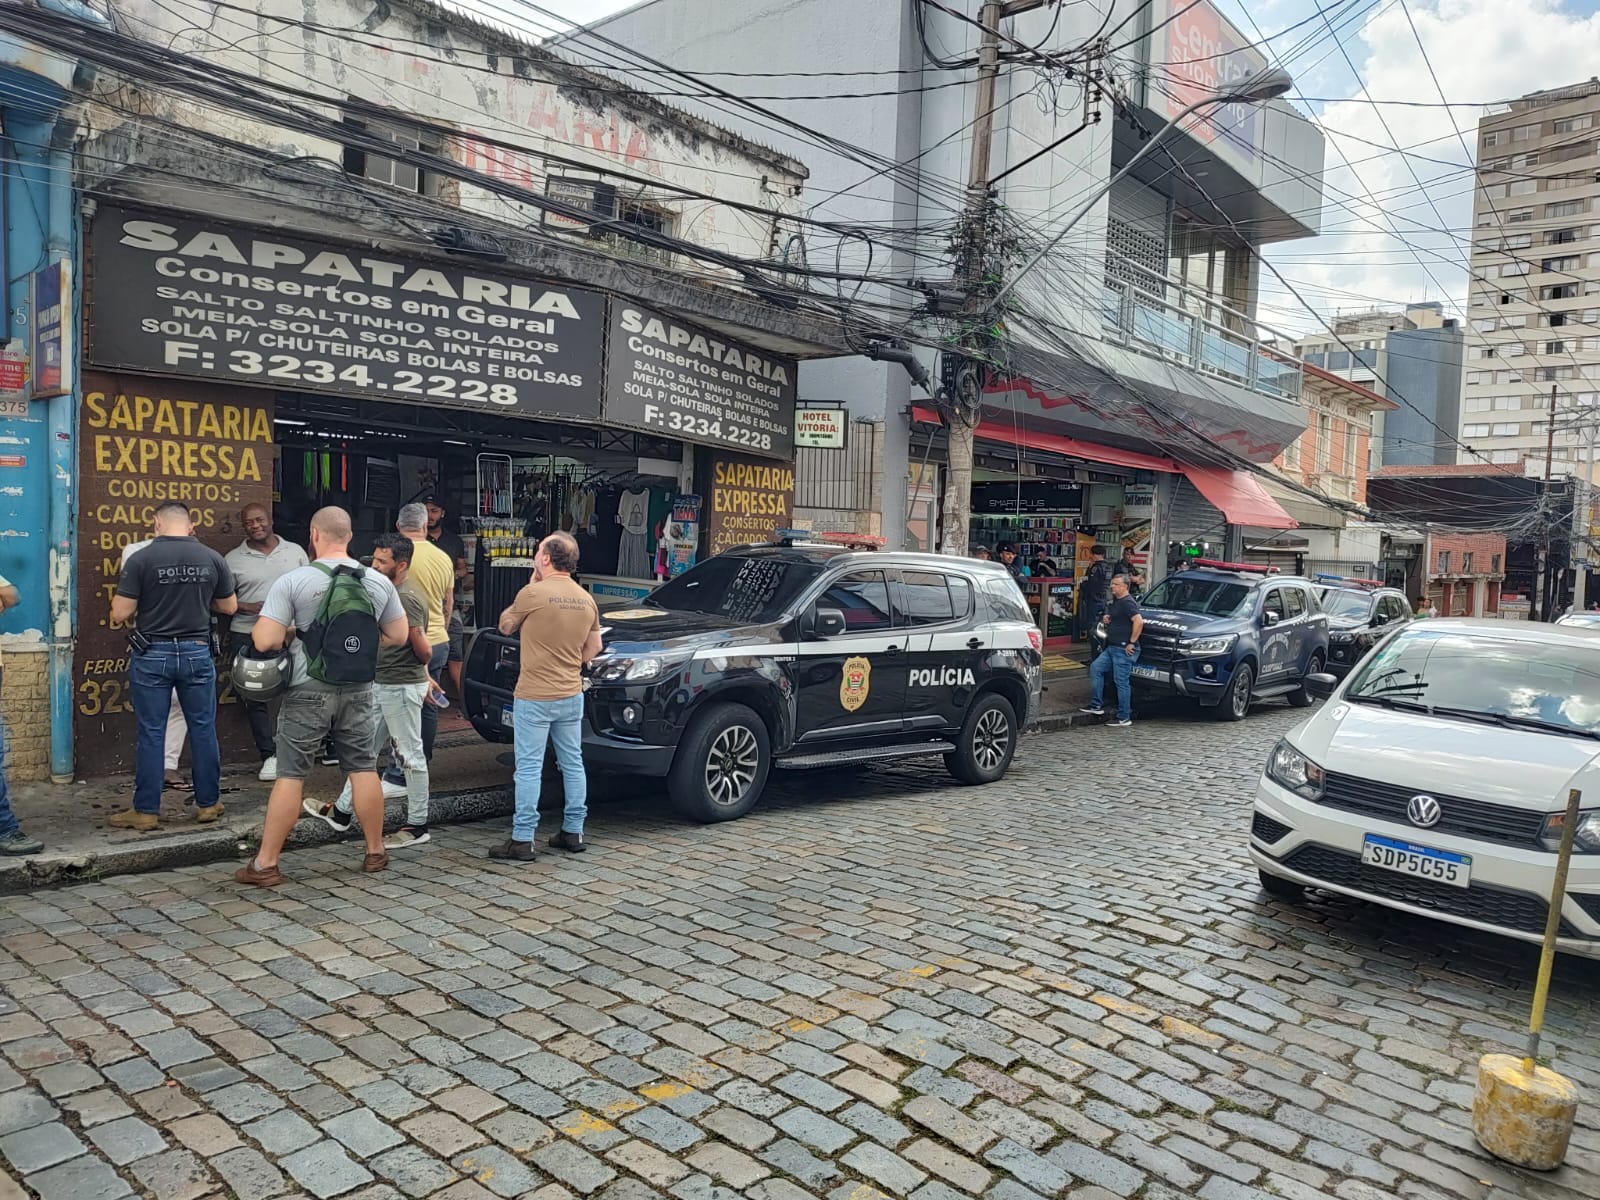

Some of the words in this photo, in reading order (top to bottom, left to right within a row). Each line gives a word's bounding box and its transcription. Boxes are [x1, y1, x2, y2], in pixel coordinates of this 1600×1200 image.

[1172, 46, 1245, 129] shopng
[119, 220, 581, 320] SAPATARIA
[155, 257, 392, 310] Consertos
[402, 300, 449, 318] em
[457, 305, 555, 335] Geral
[156, 286, 264, 310] SALTO
[275, 303, 425, 333] SALTINHO
[434, 326, 559, 353] SOLADOS
[141, 318, 218, 340] SOLA
[226, 328, 250, 344] P/
[258, 333, 400, 363] CHUTEIRAS
[407, 353, 481, 374] BOLAS
[487, 363, 499, 377] E
[504, 366, 583, 387] BOLSAS
[172, 305, 349, 339] MEIA-SOLA
[359, 331, 434, 350] SOLA
[443, 342, 544, 365] INTEIRA
[620, 309, 788, 386] SAPATARIA
[164, 341, 215, 369] F:
[228, 351, 518, 405] 3234.2228
[628, 336, 718, 378] Consertos
[721, 371, 743, 386] em
[746, 375, 781, 398] Geral
[634, 359, 675, 380] SALTO
[678, 373, 733, 397] SALTINHO
[735, 391, 779, 411] SOLADOS
[86, 392, 273, 443] SAPATARIA
[624, 381, 653, 399] SOLA
[658, 390, 668, 402] P/
[670, 394, 722, 417] CHUTEIRAS
[725, 409, 751, 425] BOLAS
[753, 417, 758, 427] E
[759, 417, 788, 435] BOLSAS
[632, 371, 700, 398] MEIA-SOLA
[704, 392, 732, 407] SOLA
[734, 400, 770, 418] INTEIRA
[803, 412, 832, 422] HOTEL
[644, 403, 665, 426] F:
[668, 411, 772, 450] 3234.2228
[95, 434, 262, 481] EXPRESSA
[715, 461, 794, 492] SAPATARIA
[97, 504, 215, 528] CALÇOS
[108, 479, 240, 502] CONSERTOS:
[714, 488, 786, 516] EXPRESSA
[158, 565, 210, 578] POLÍCIA
[908, 664, 976, 687] POLÍCIA
[1371, 846, 1459, 881] SDP5C55
